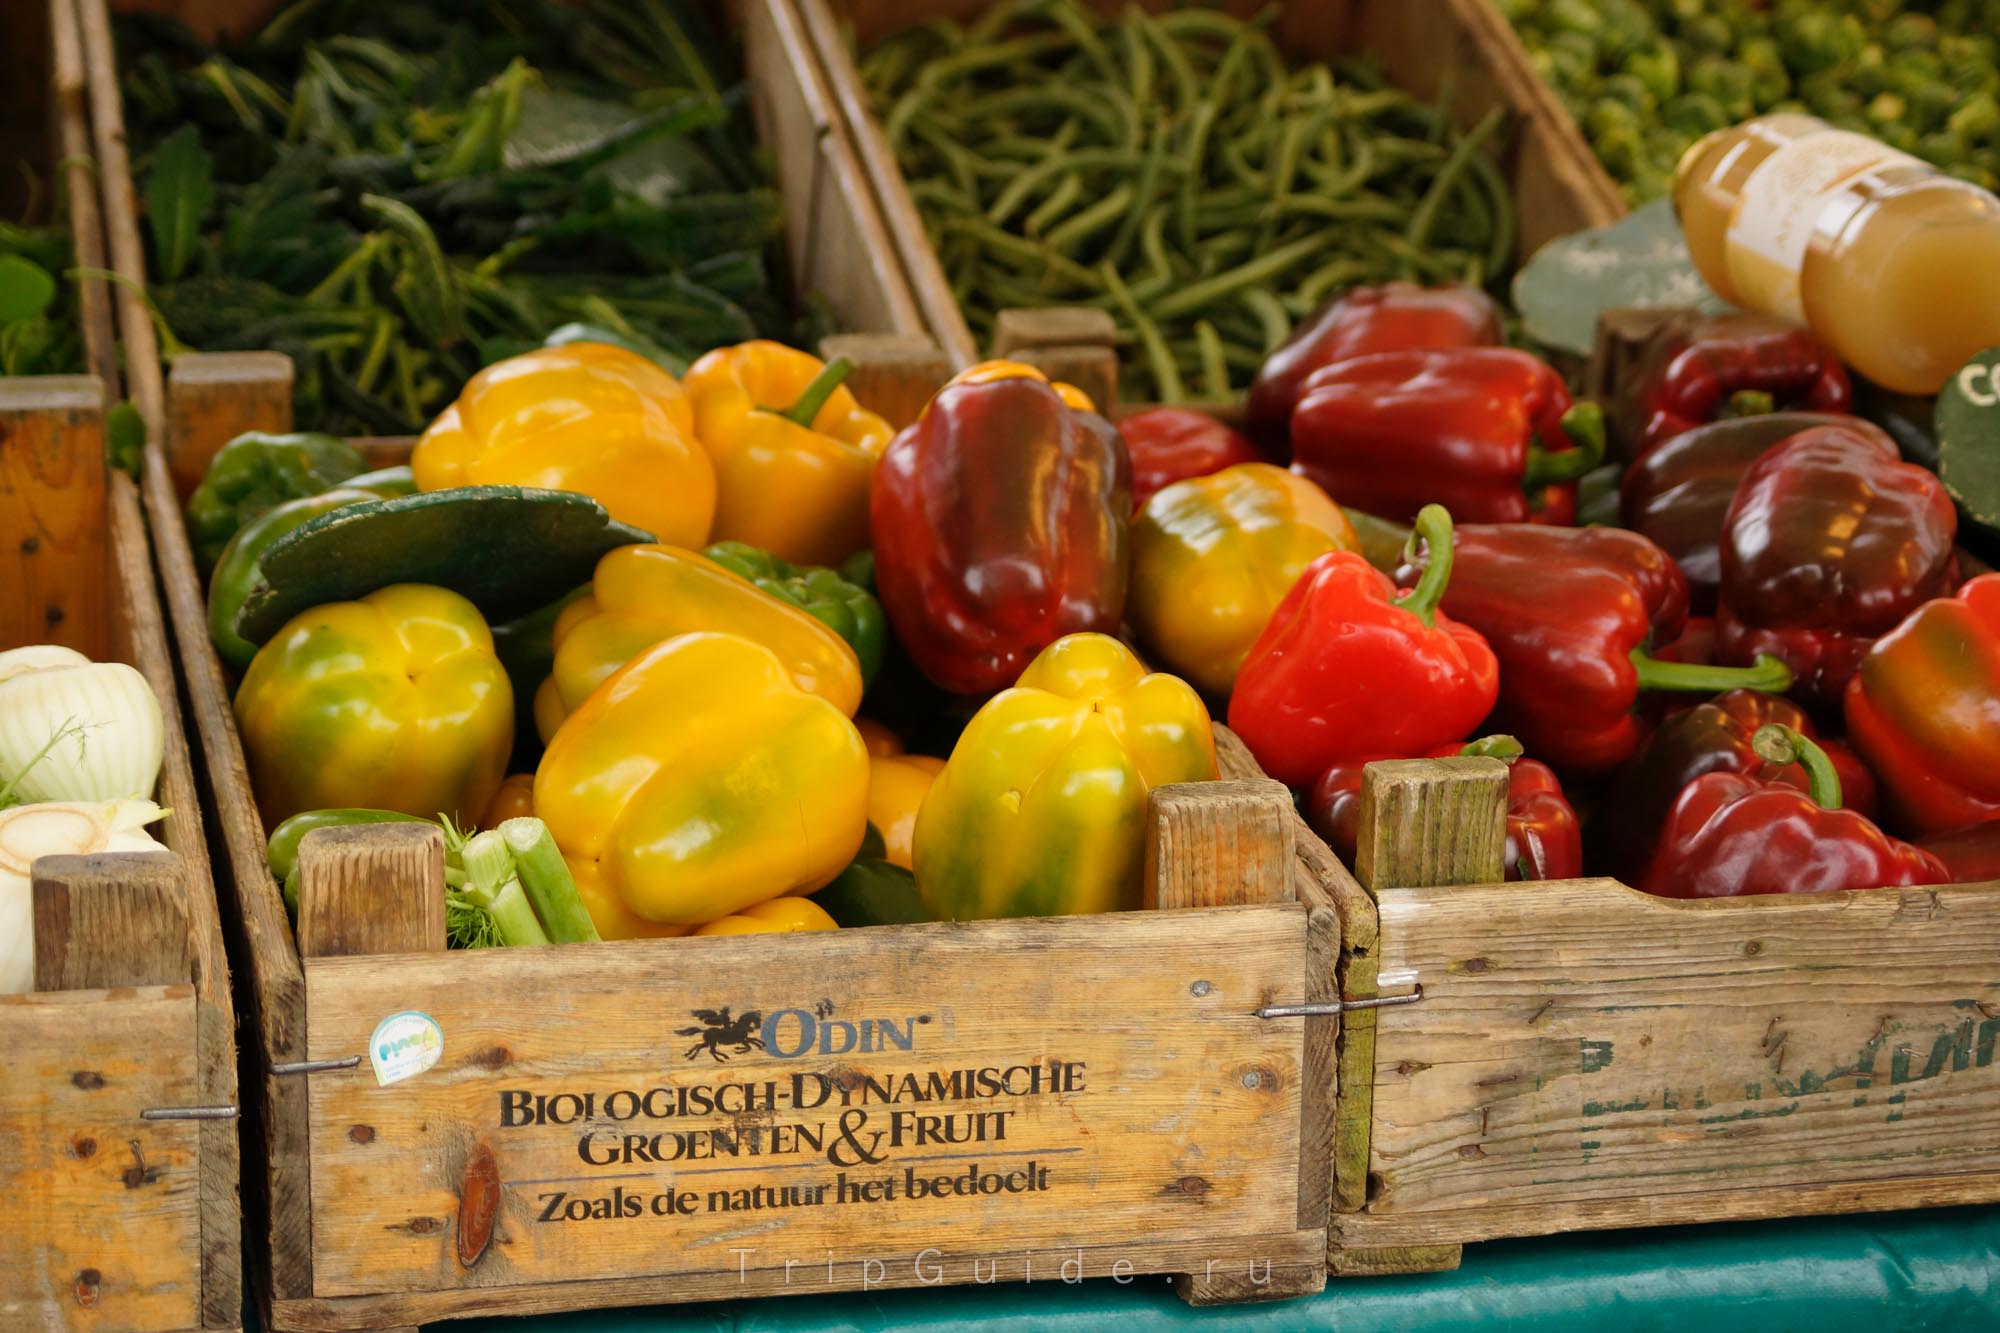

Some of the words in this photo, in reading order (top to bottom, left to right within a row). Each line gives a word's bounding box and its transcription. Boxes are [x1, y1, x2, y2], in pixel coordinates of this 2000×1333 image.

[760, 1008, 915, 1058] ODIN
[577, 1122, 825, 1166] GROENTEN
[826, 1109, 889, 1168] &
[890, 1110, 1015, 1147] FRUIT
[537, 1186, 642, 1223] Zoals
[651, 1186, 699, 1216] de
[707, 1182, 832, 1213] natuur
[836, 1172, 897, 1205] het
[904, 1160, 1051, 1200] bedoelt
